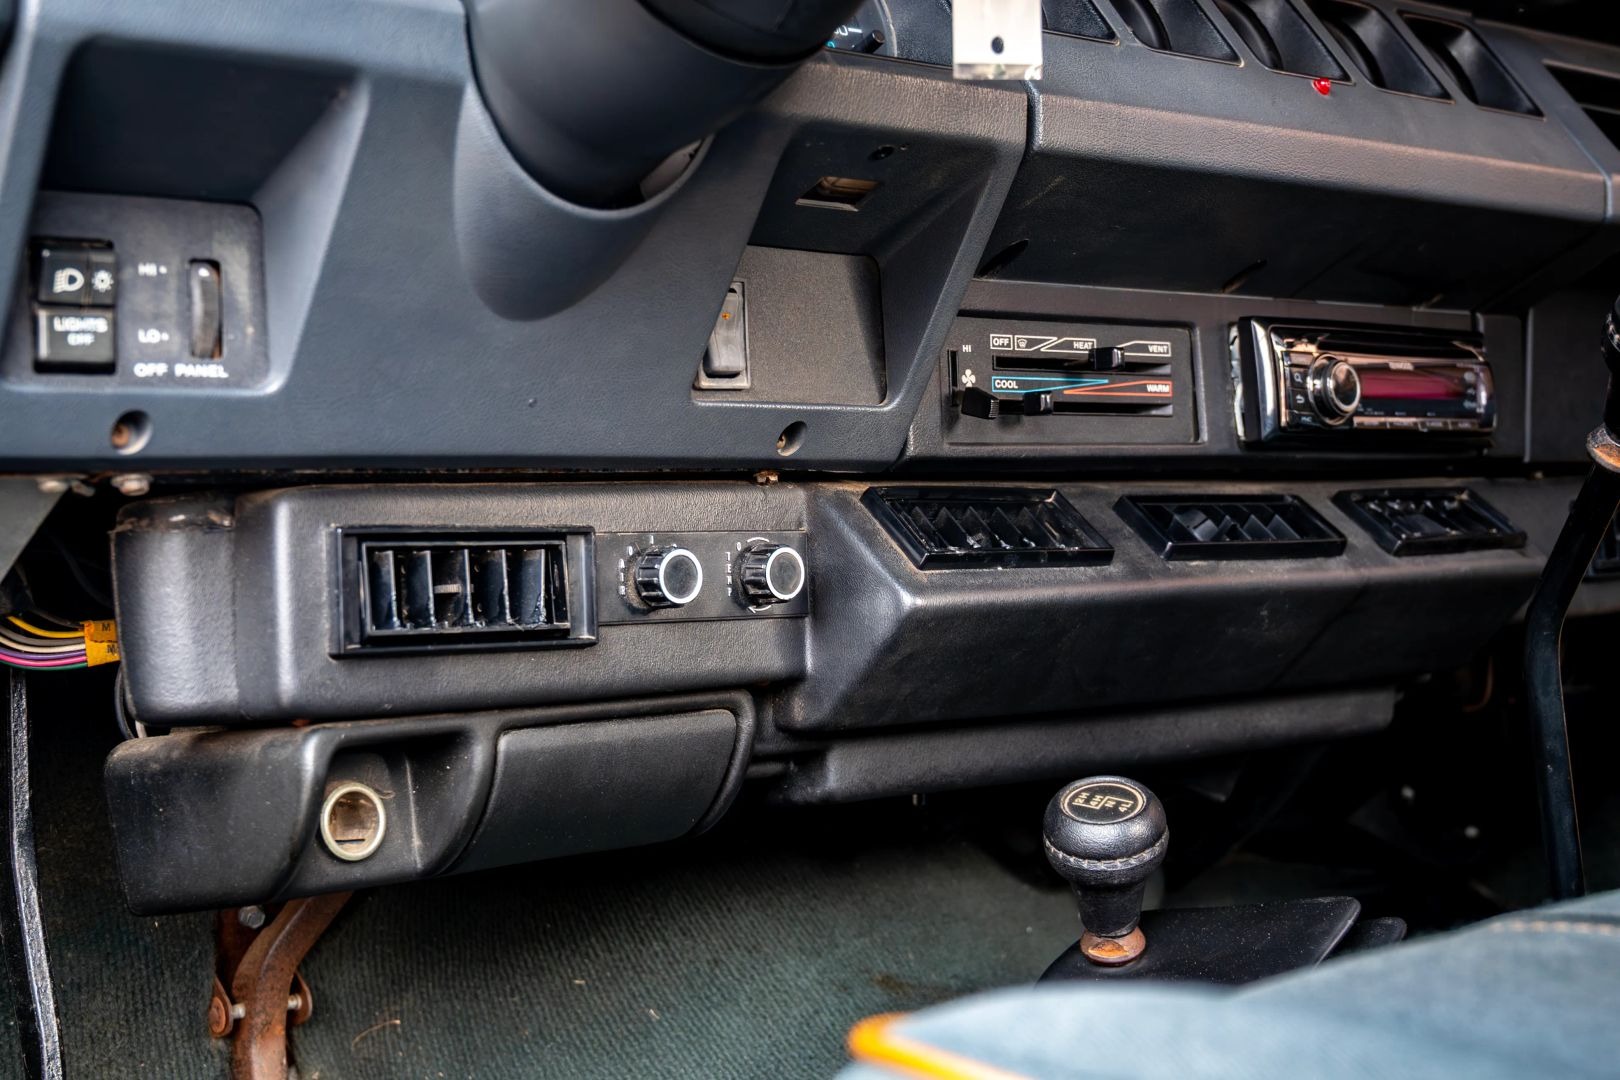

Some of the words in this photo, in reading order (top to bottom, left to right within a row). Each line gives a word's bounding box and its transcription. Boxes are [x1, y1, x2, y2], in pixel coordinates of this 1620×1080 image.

[138, 262, 157, 277] HI
[53, 316, 109, 333] LIGHTS
[138, 328, 161, 344] LO
[992, 337, 1010, 347] OFF
[1073, 341, 1094, 350] HEAT
[962, 344, 972, 353] HI
[1147, 344, 1169, 354] VENT
[133, 363, 169, 378] OFF
[174, 363, 230, 378] PANEL
[994, 379, 1019, 389] COOL
[1146, 383, 1170, 393] WARM
[1074, 792, 1090, 804] 2H
[1090, 794, 1104, 806] 4H
